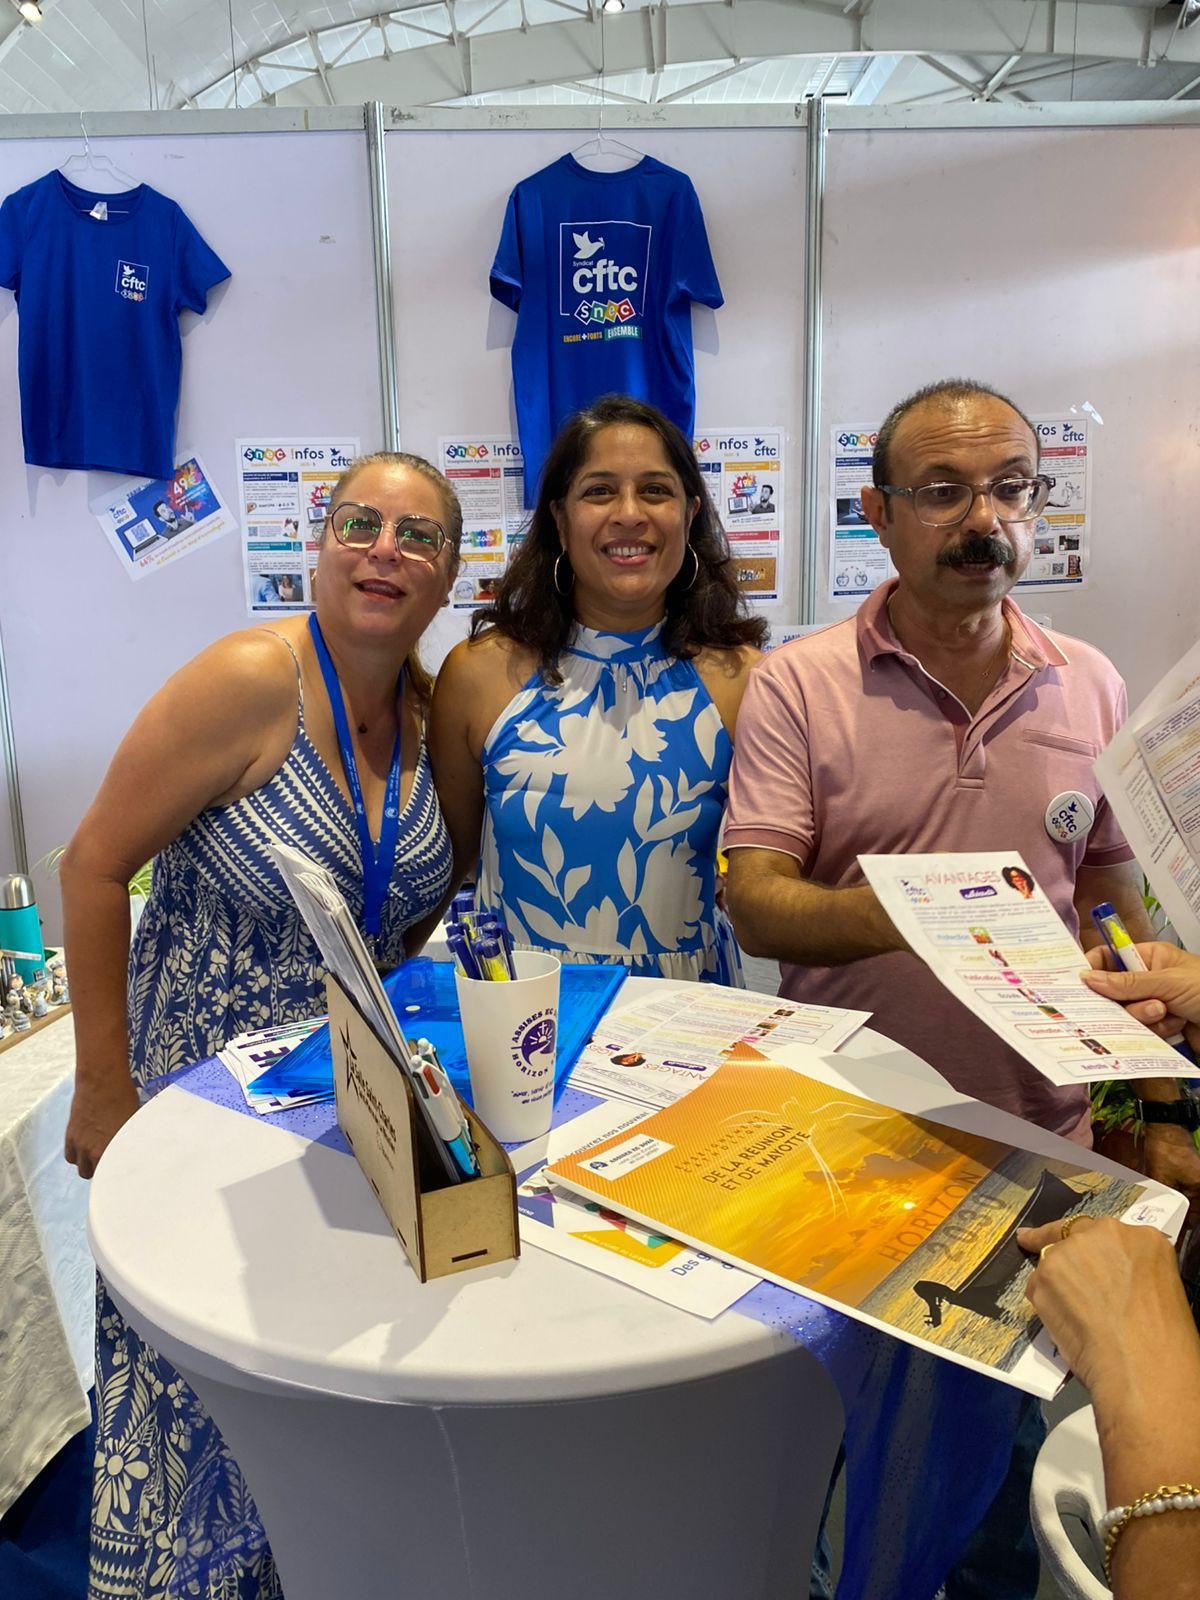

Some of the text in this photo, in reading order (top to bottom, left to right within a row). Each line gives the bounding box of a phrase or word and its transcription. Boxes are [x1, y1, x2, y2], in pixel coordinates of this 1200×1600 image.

[121, 277, 146, 291] cftc
[573, 259, 638, 294] cftc
[577, 301, 633, 322] snec
[608, 325, 639, 339] ENSEMBLE
[1062, 432, 1085, 442] cftc
[245, 448, 286, 460] snec
[447, 444, 522, 458] snec !nfo
[754, 446, 777, 456] cftc
[330, 456, 354, 467] cftc
[1058, 810, 1077, 833] cftc
[924, 871, 1001, 885] AVANTAGES
[511, 1010, 543, 1044] ASSISES
[643, 1062, 710, 1081] ANTAGES
[720, 1131, 811, 1191] ET DE MAYOTTE
[702, 1170, 726, 1184] DE
[720, 1160, 743, 1173] LA
[878, 1170, 982, 1263] HORIZON
[670, 1259, 700, 1277] Des
